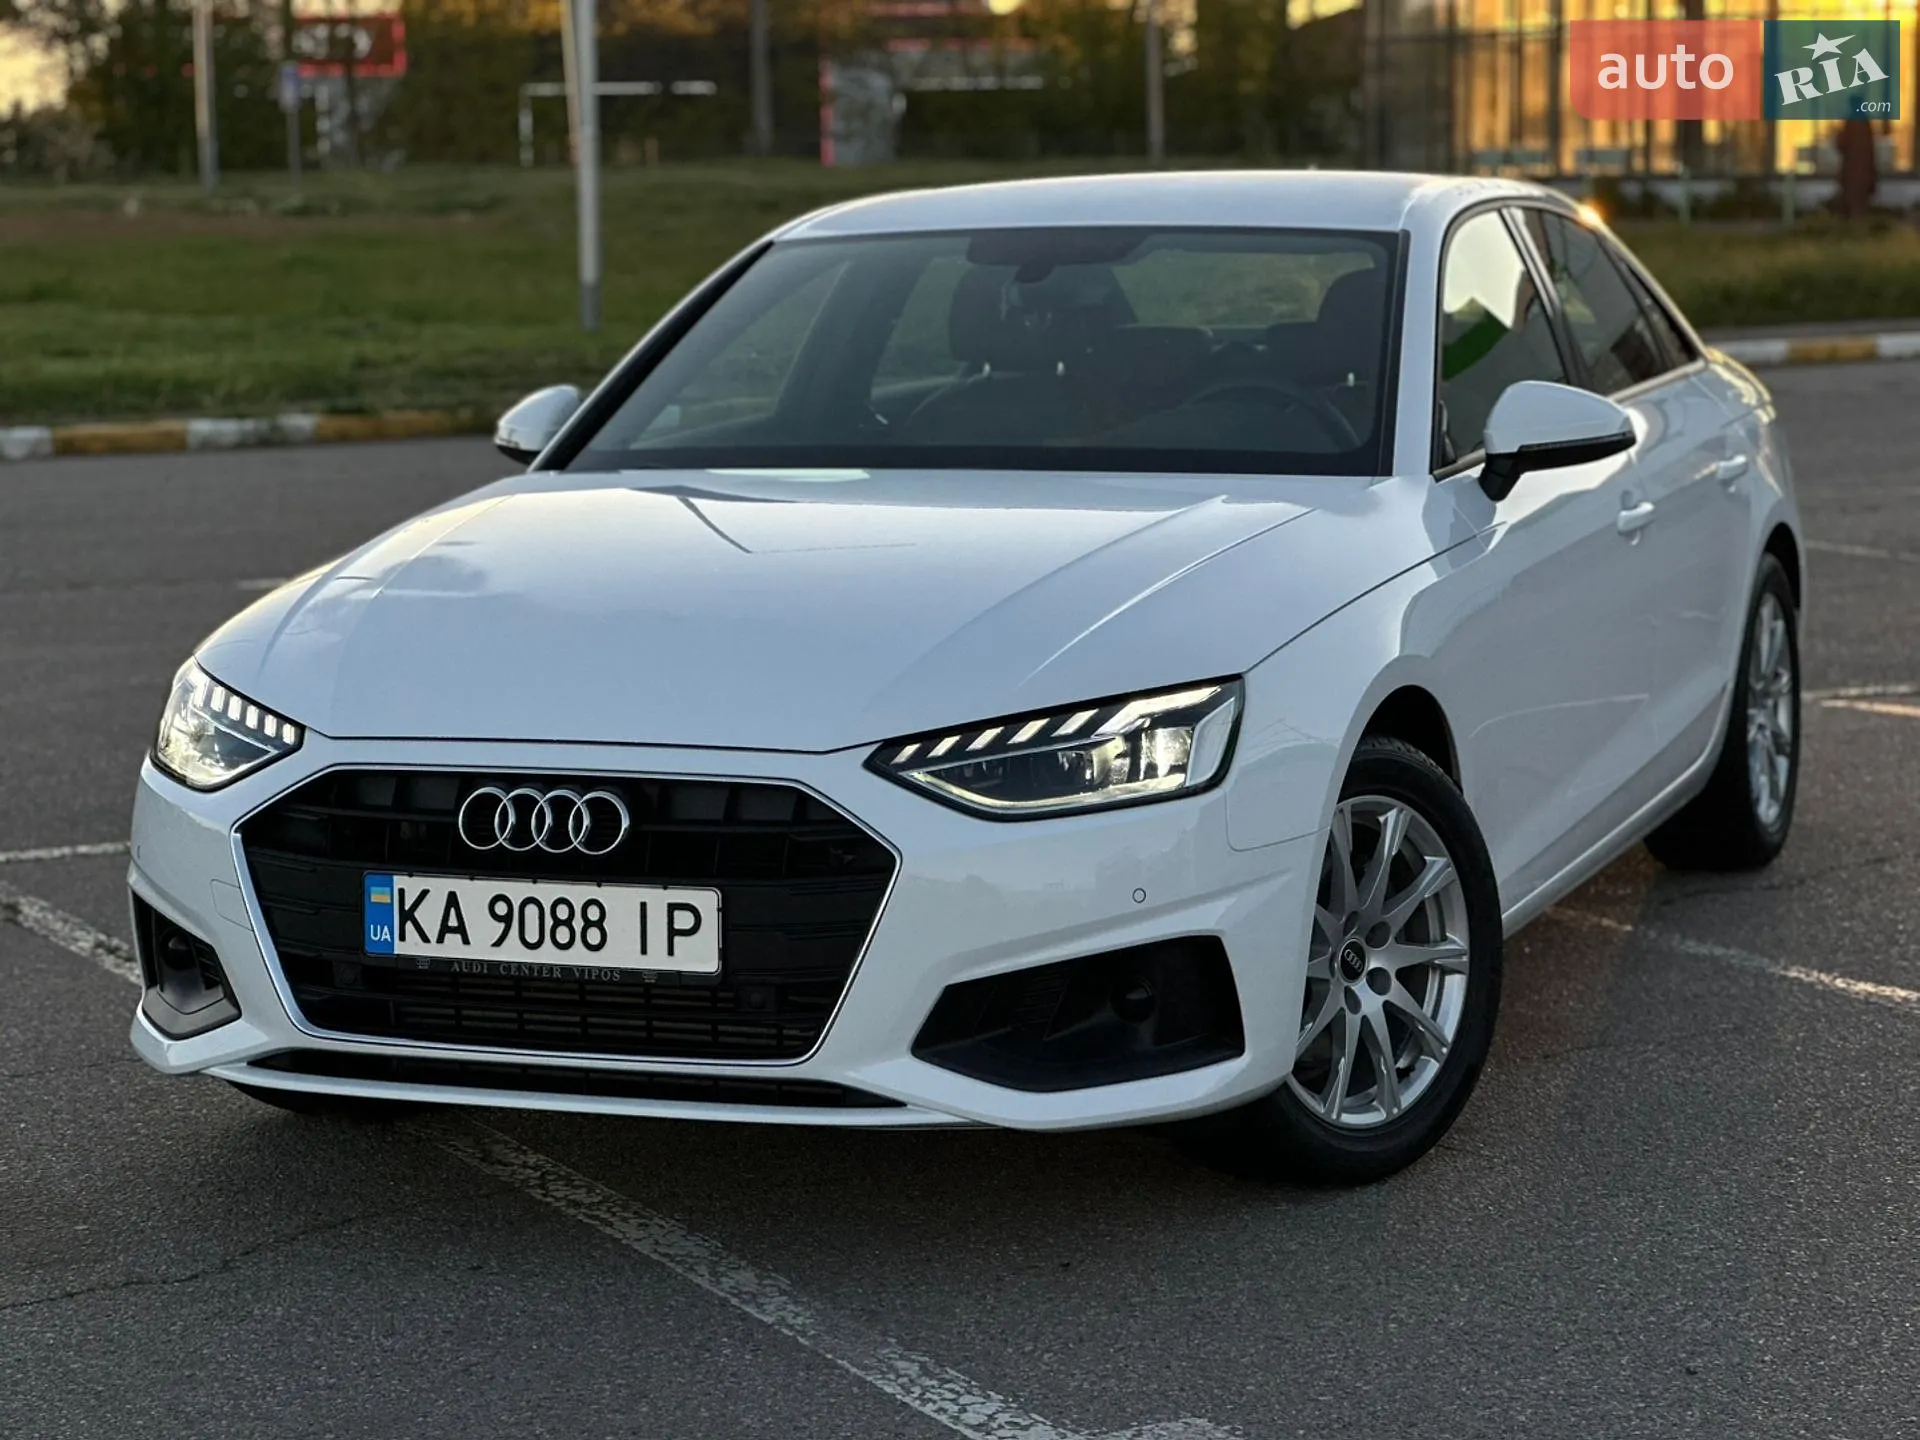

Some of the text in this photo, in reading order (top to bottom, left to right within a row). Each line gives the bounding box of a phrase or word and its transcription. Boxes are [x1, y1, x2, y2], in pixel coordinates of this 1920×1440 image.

[398, 887, 702, 957] KA 9088 IP
[370, 924, 391, 942] UA
[450, 960, 621, 981] AUDI CENTER VIPOS
